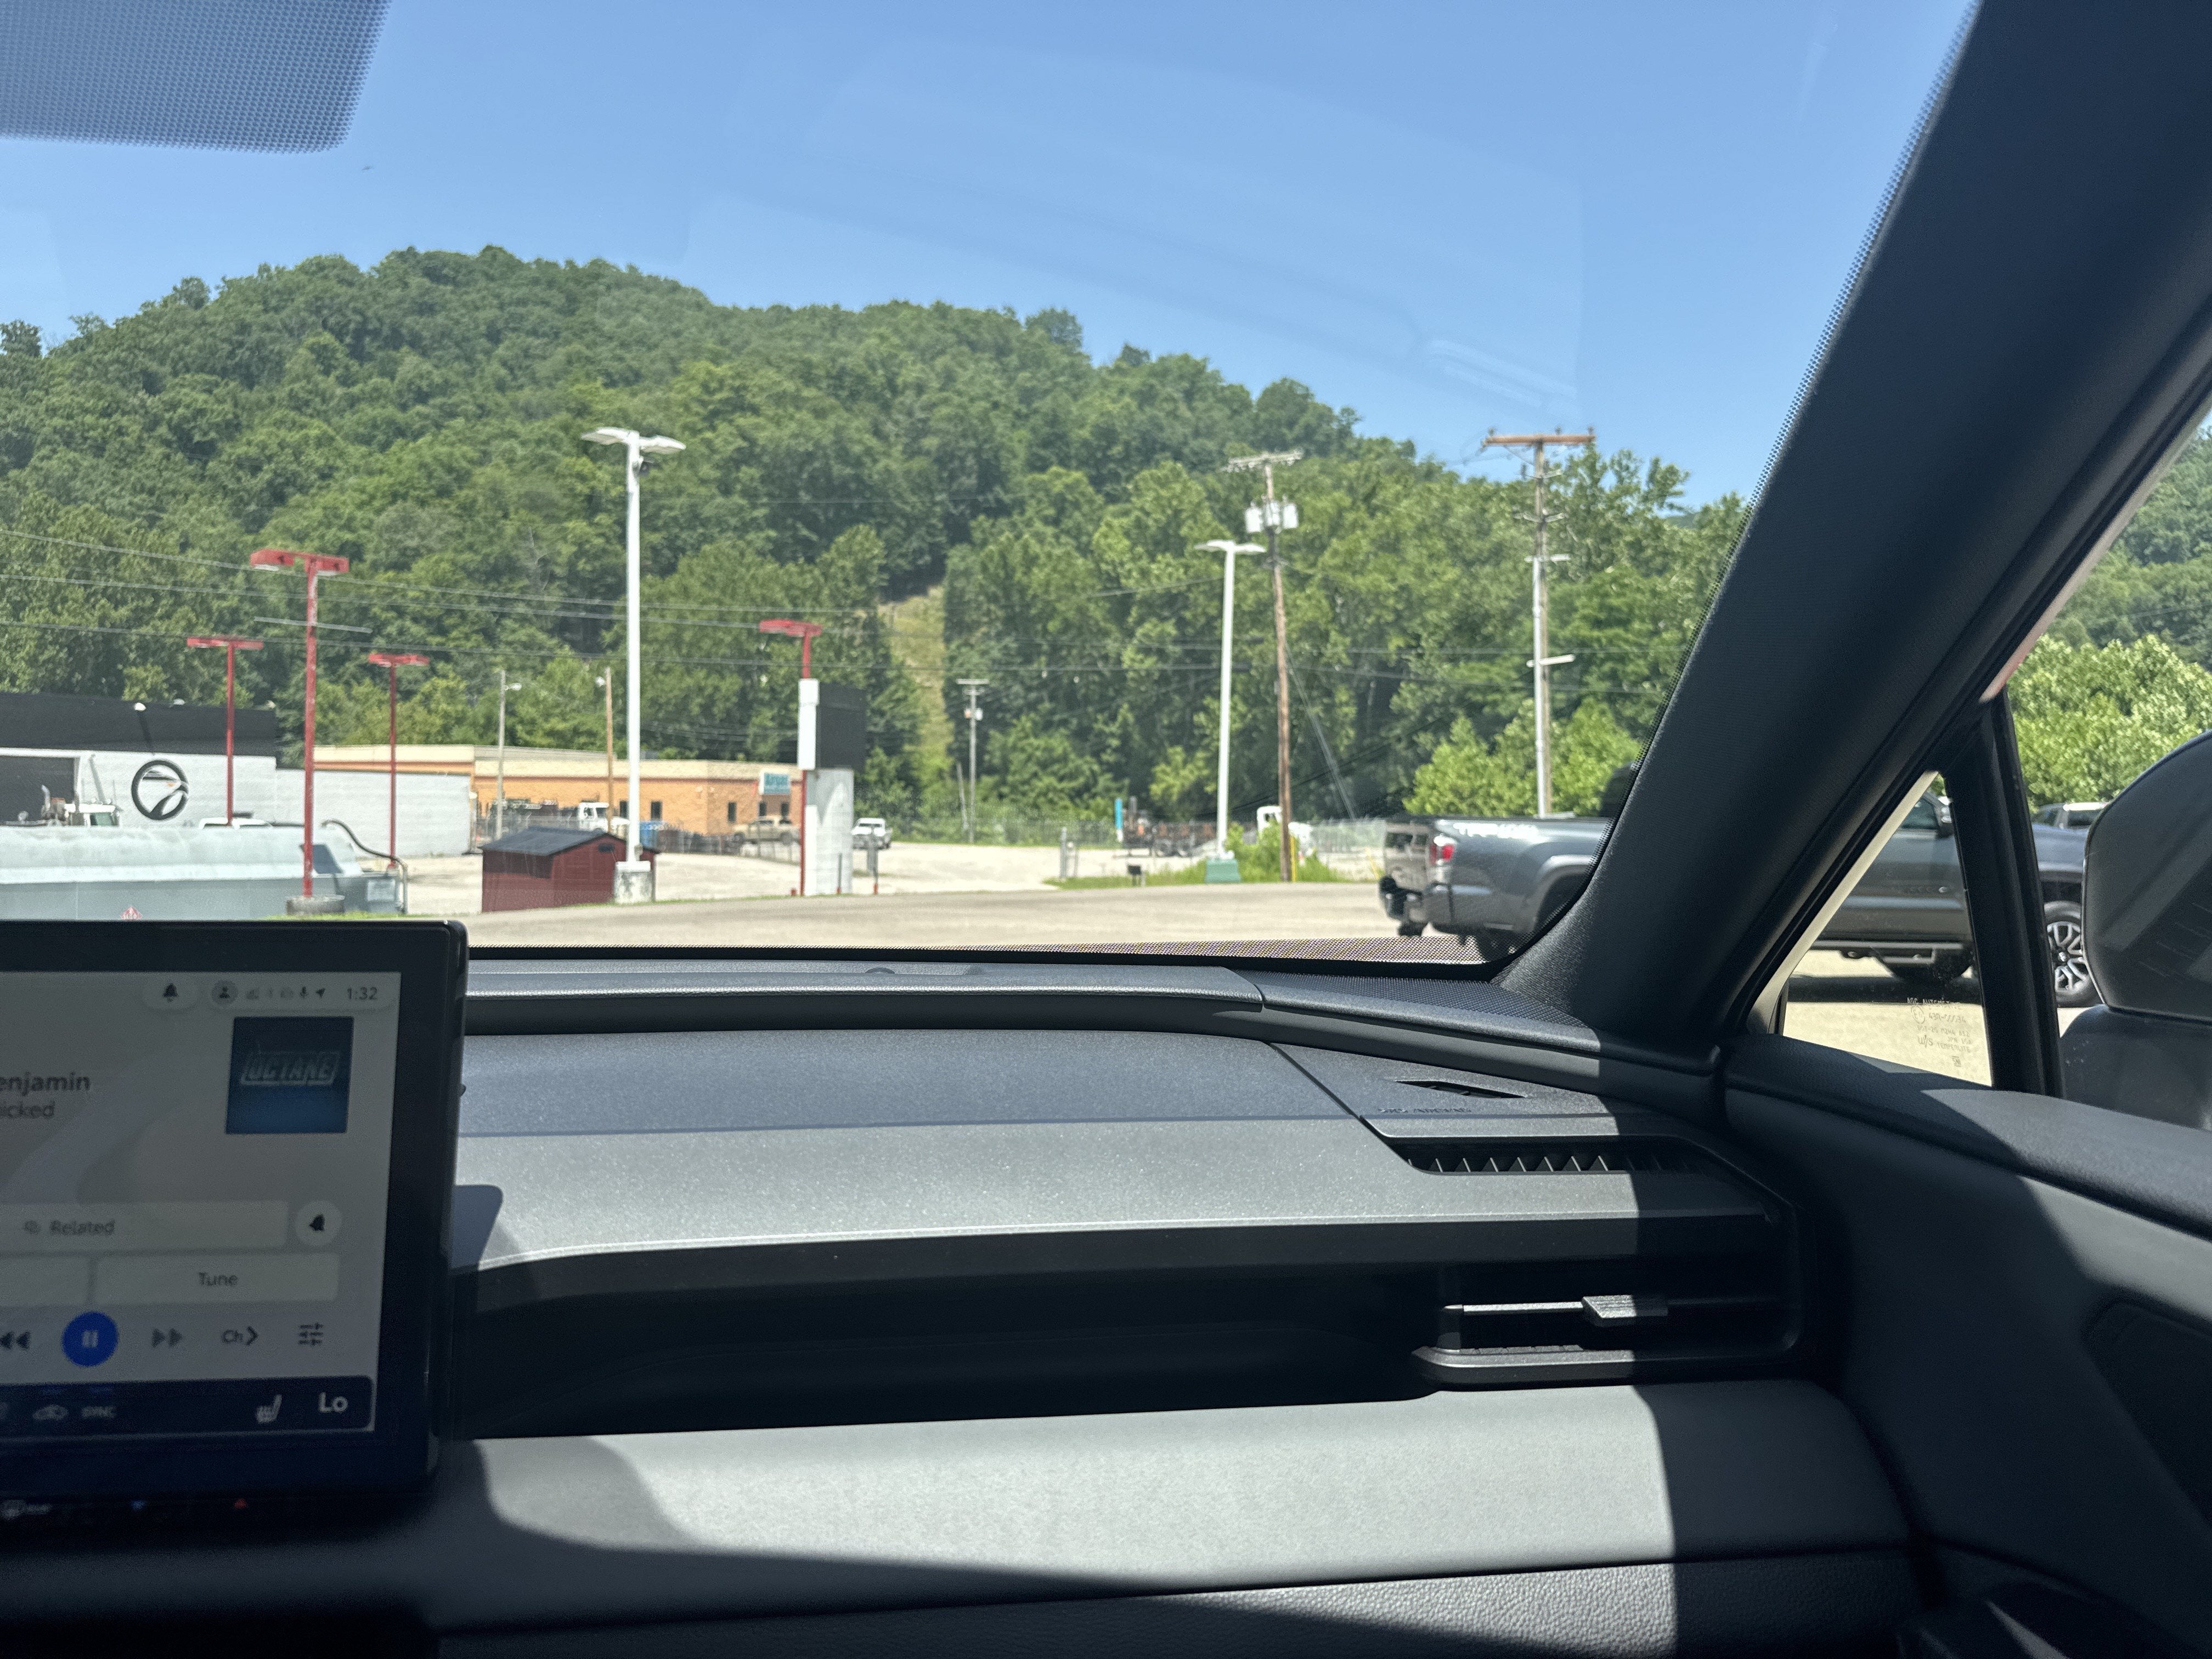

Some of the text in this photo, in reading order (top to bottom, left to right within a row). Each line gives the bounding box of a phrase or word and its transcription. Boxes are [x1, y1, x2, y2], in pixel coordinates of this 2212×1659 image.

[347, 986, 378, 1001] 1:32
[247, 1056, 332, 1080] OCTANE
[0, 1101, 55, 1119] icked
[50, 1220, 115, 1235] Related
[198, 1272, 238, 1286] Tune
[319, 1392, 348, 1413] Lo
